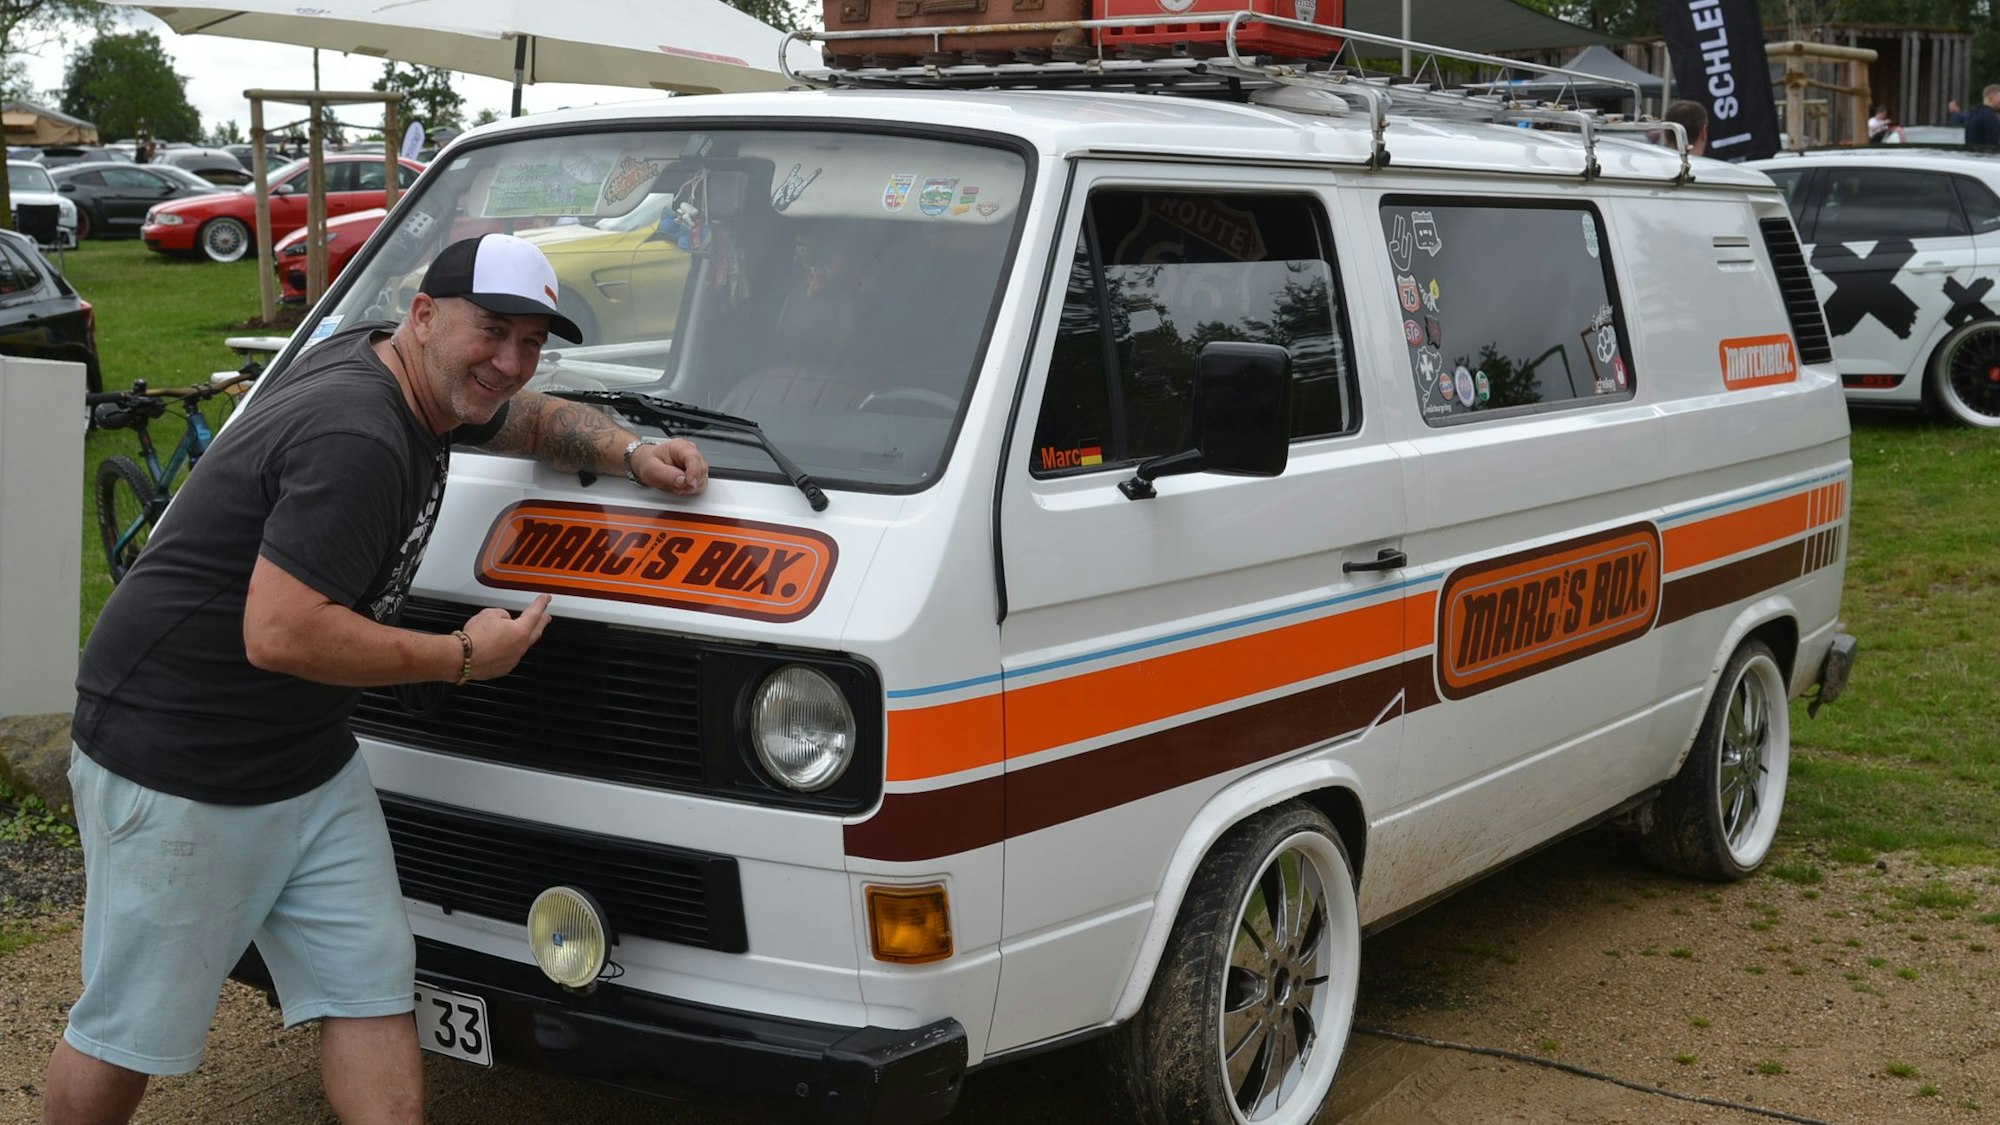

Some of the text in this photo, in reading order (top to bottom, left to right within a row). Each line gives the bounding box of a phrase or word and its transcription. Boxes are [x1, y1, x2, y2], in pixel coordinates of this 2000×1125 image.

[1160, 198, 1249, 250] ROUTE
[1403, 286, 1417, 309] 76
[1406, 323, 1420, 341] STP
[1862, 375, 1894, 385] GTI
[1041, 447, 1080, 470] Marc
[432, 998, 483, 1055] 33
